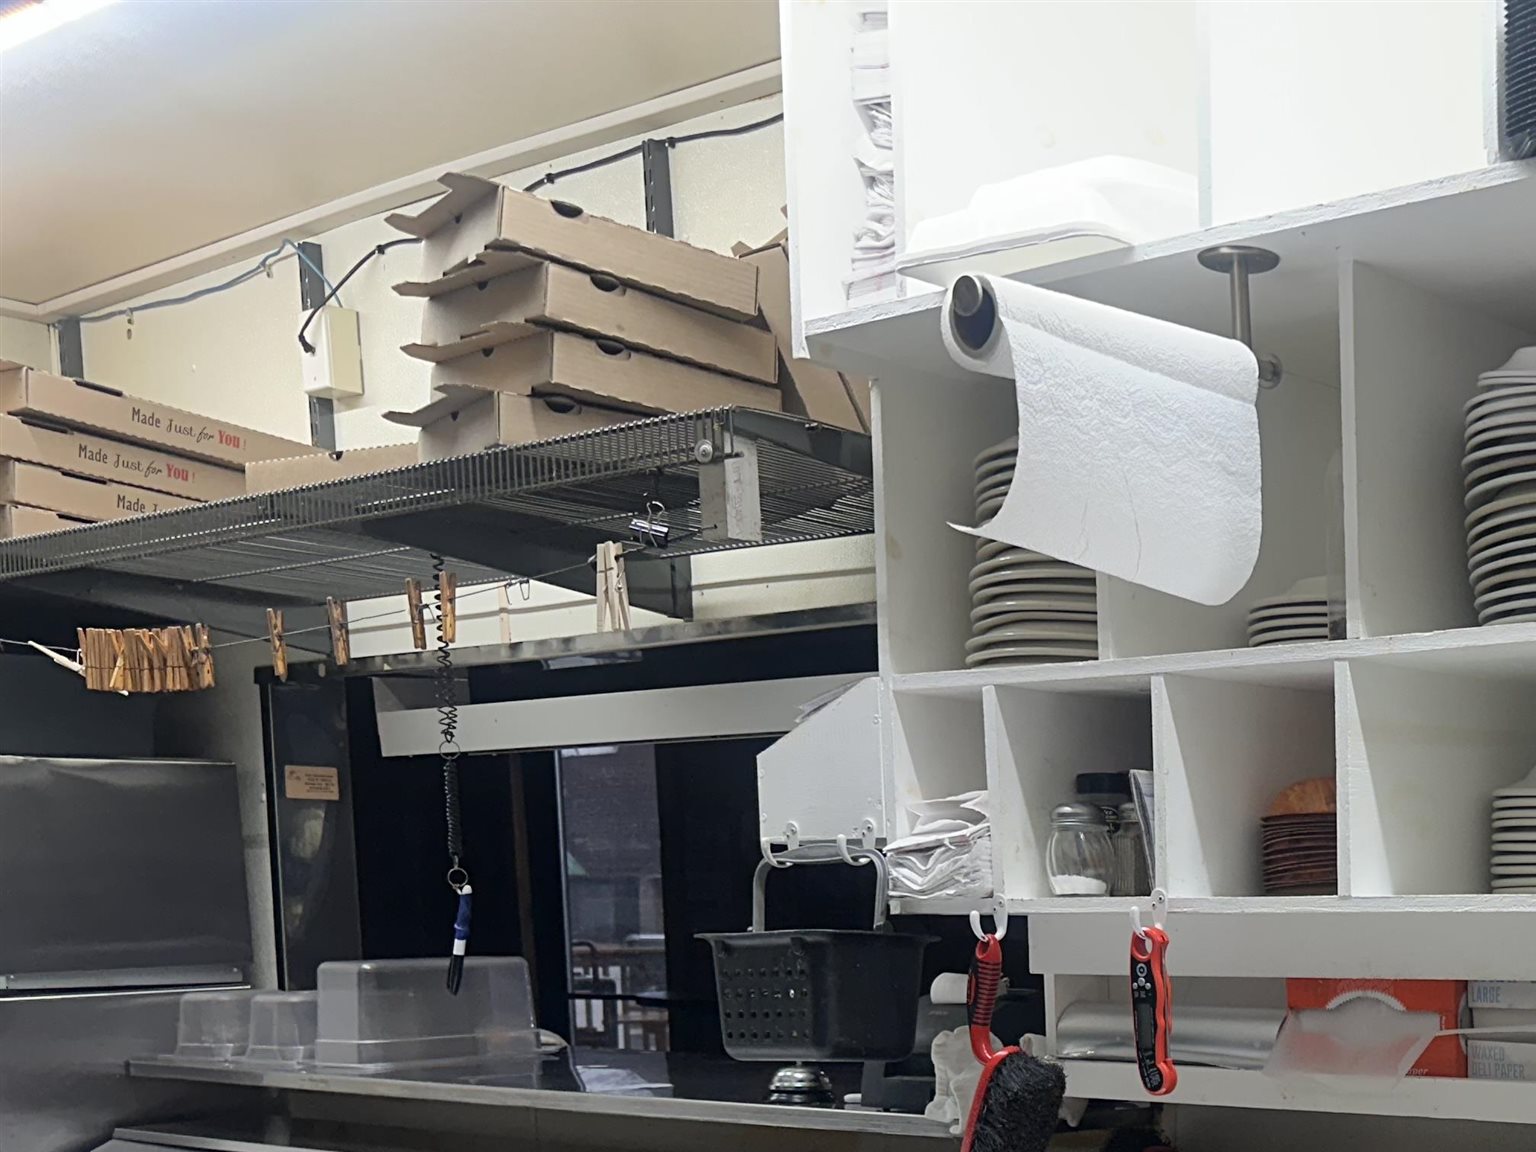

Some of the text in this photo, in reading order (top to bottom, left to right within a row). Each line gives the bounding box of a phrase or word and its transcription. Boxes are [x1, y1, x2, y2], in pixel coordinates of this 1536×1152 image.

[132, 406, 160, 428] Made
[166, 418, 196, 438] Just
[196, 427, 214, 444] for
[218, 430, 240, 448] You
[78, 444, 108, 464] Made
[113, 453, 144, 473] Just
[144, 460, 164, 478] for
[166, 463, 189, 482] You
[116, 494, 146, 514] Made
[1471, 986, 1501, 1003] LARGE
[1471, 1046, 1505, 1062] WAXED
[1471, 1062, 1526, 1079] DELI PAPER
